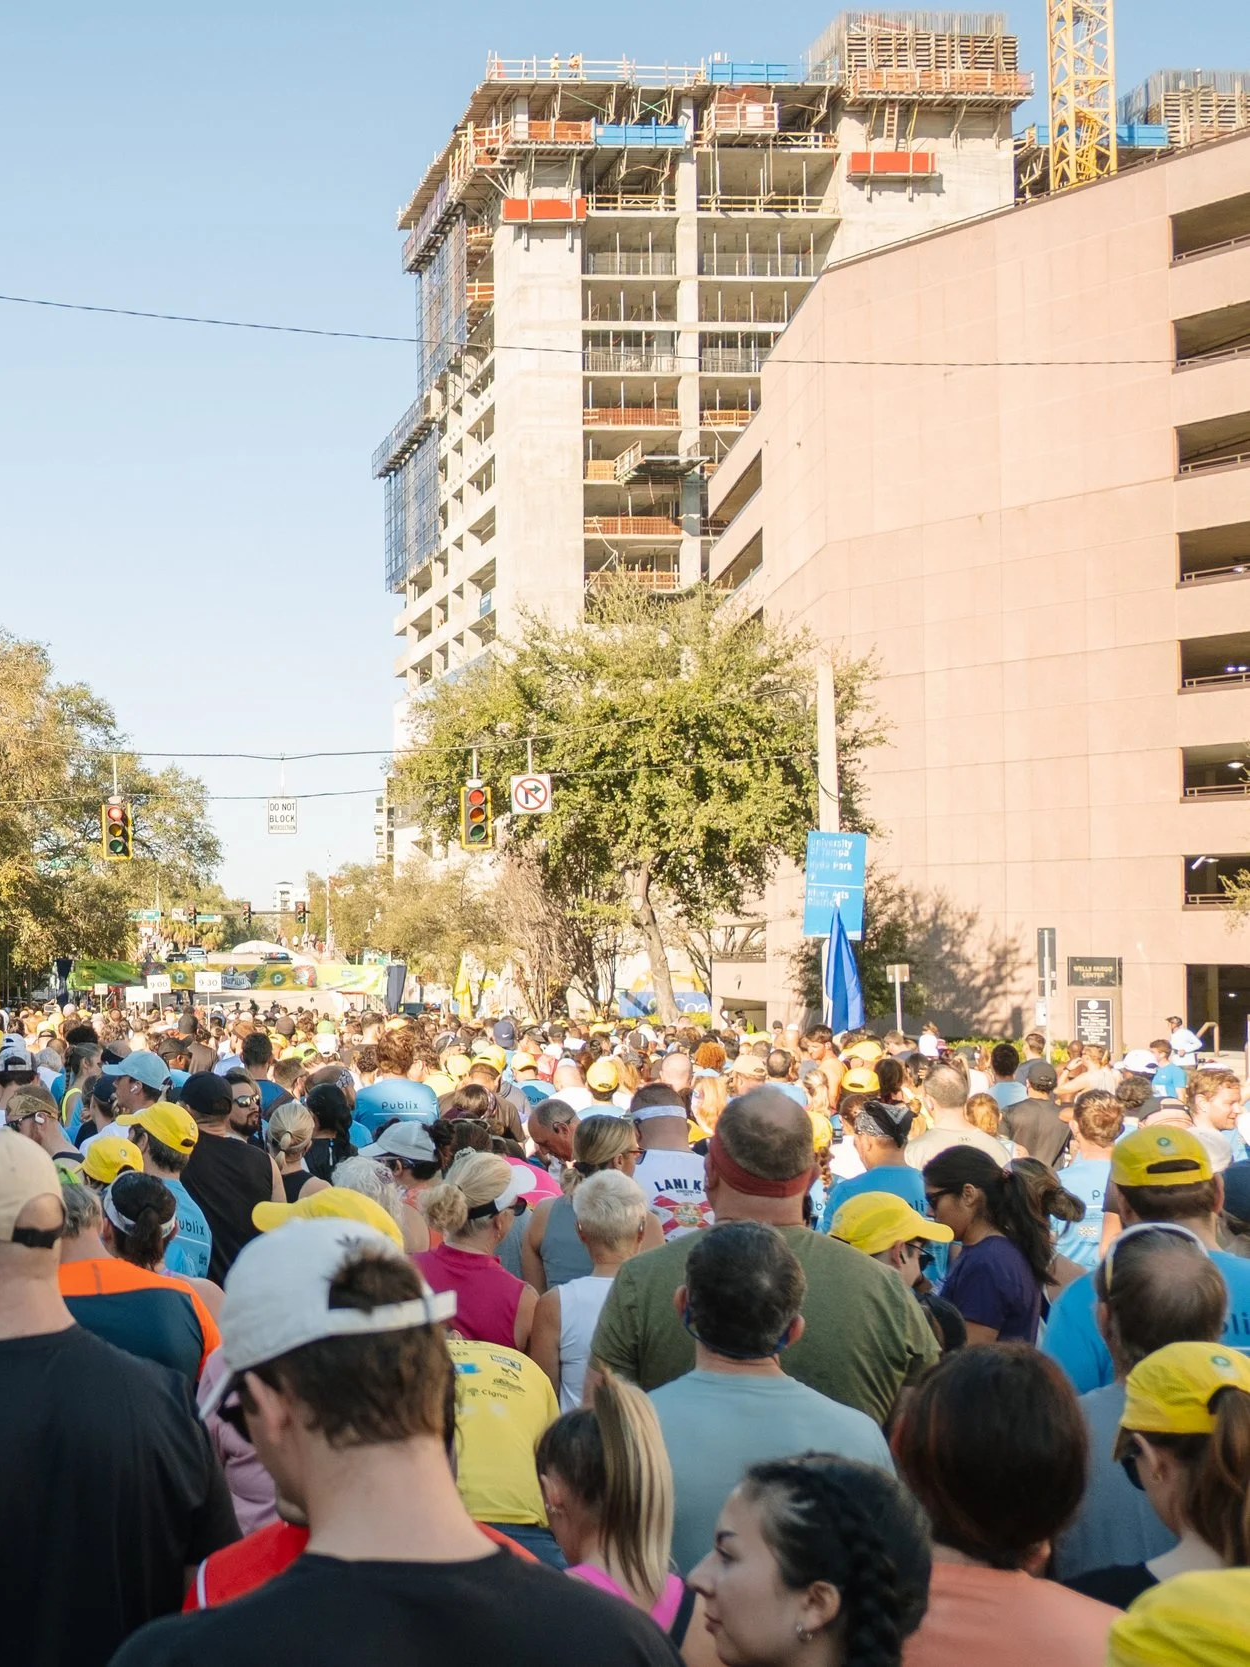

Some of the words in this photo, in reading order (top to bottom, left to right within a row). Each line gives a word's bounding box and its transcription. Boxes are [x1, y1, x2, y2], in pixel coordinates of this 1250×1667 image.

[270, 803, 279, 811] DO
[282, 803, 295, 811] NOT
[270, 815, 295, 823] BLOCK
[382, 1101, 419, 1110] Publix
[654, 1178, 688, 1193] LANI
[179, 1219, 205, 1236] ublix
[481, 1388, 509, 1400] Cigna
